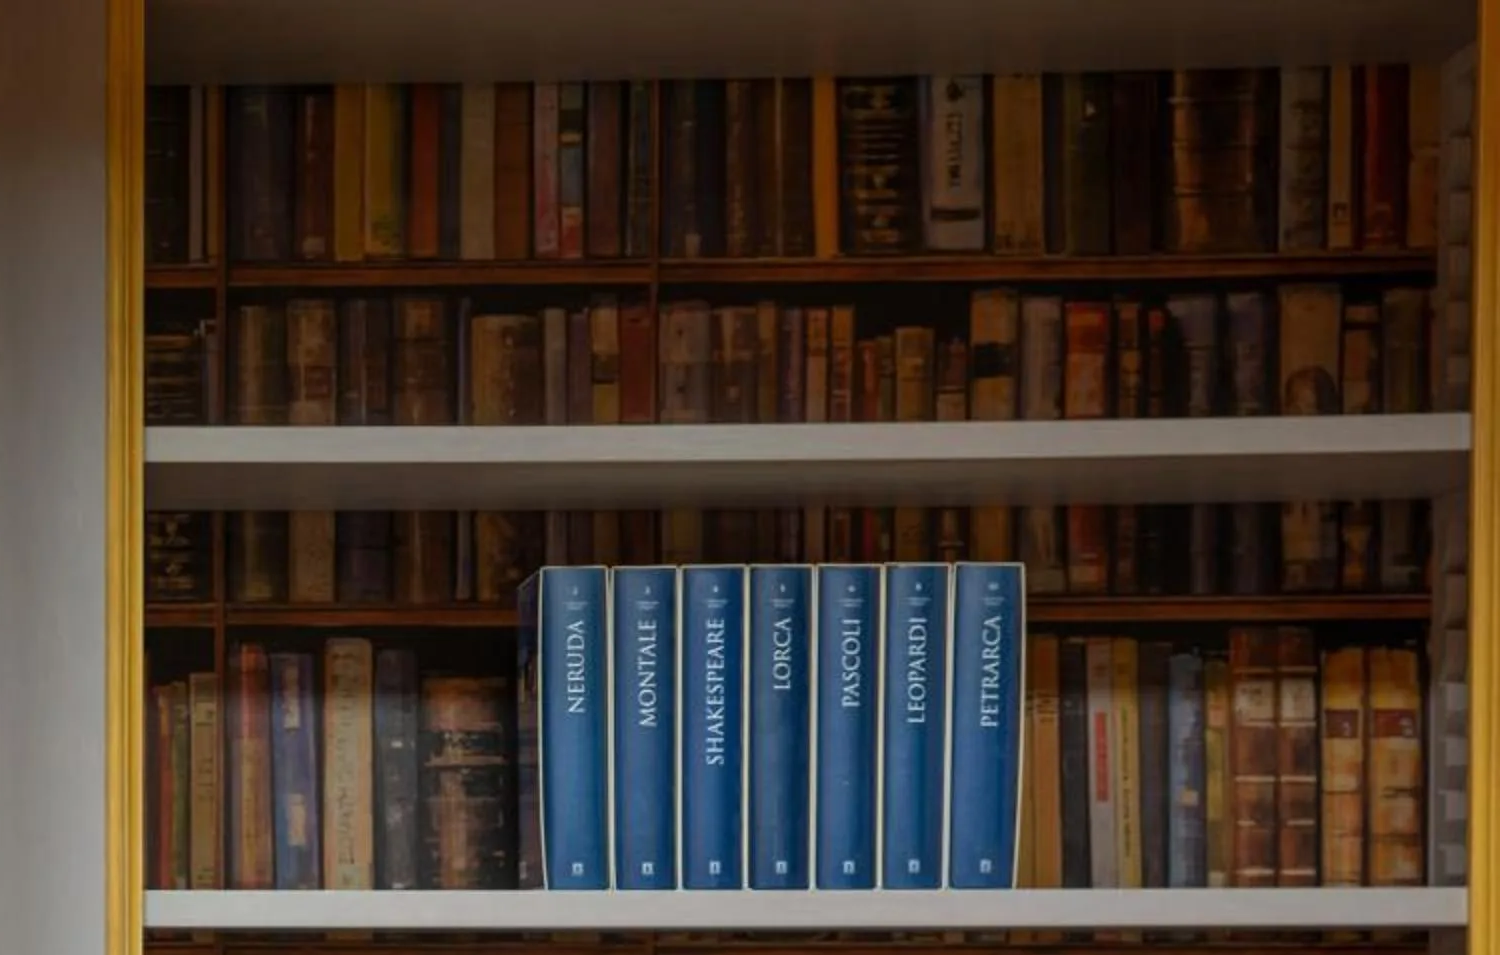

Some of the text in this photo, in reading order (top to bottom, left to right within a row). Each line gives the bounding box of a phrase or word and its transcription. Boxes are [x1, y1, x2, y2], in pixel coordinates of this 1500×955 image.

[567, 620, 585, 713] NERUDA
[638, 620, 656, 726] MONTALE
[706, 618, 724, 765] SHAKESPEARE
[773, 618, 791, 690] LORCA
[841, 619, 860, 707] PASCOLI
[907, 617, 926, 723] LEOPARDI
[980, 616, 1000, 727] PETRARCA
